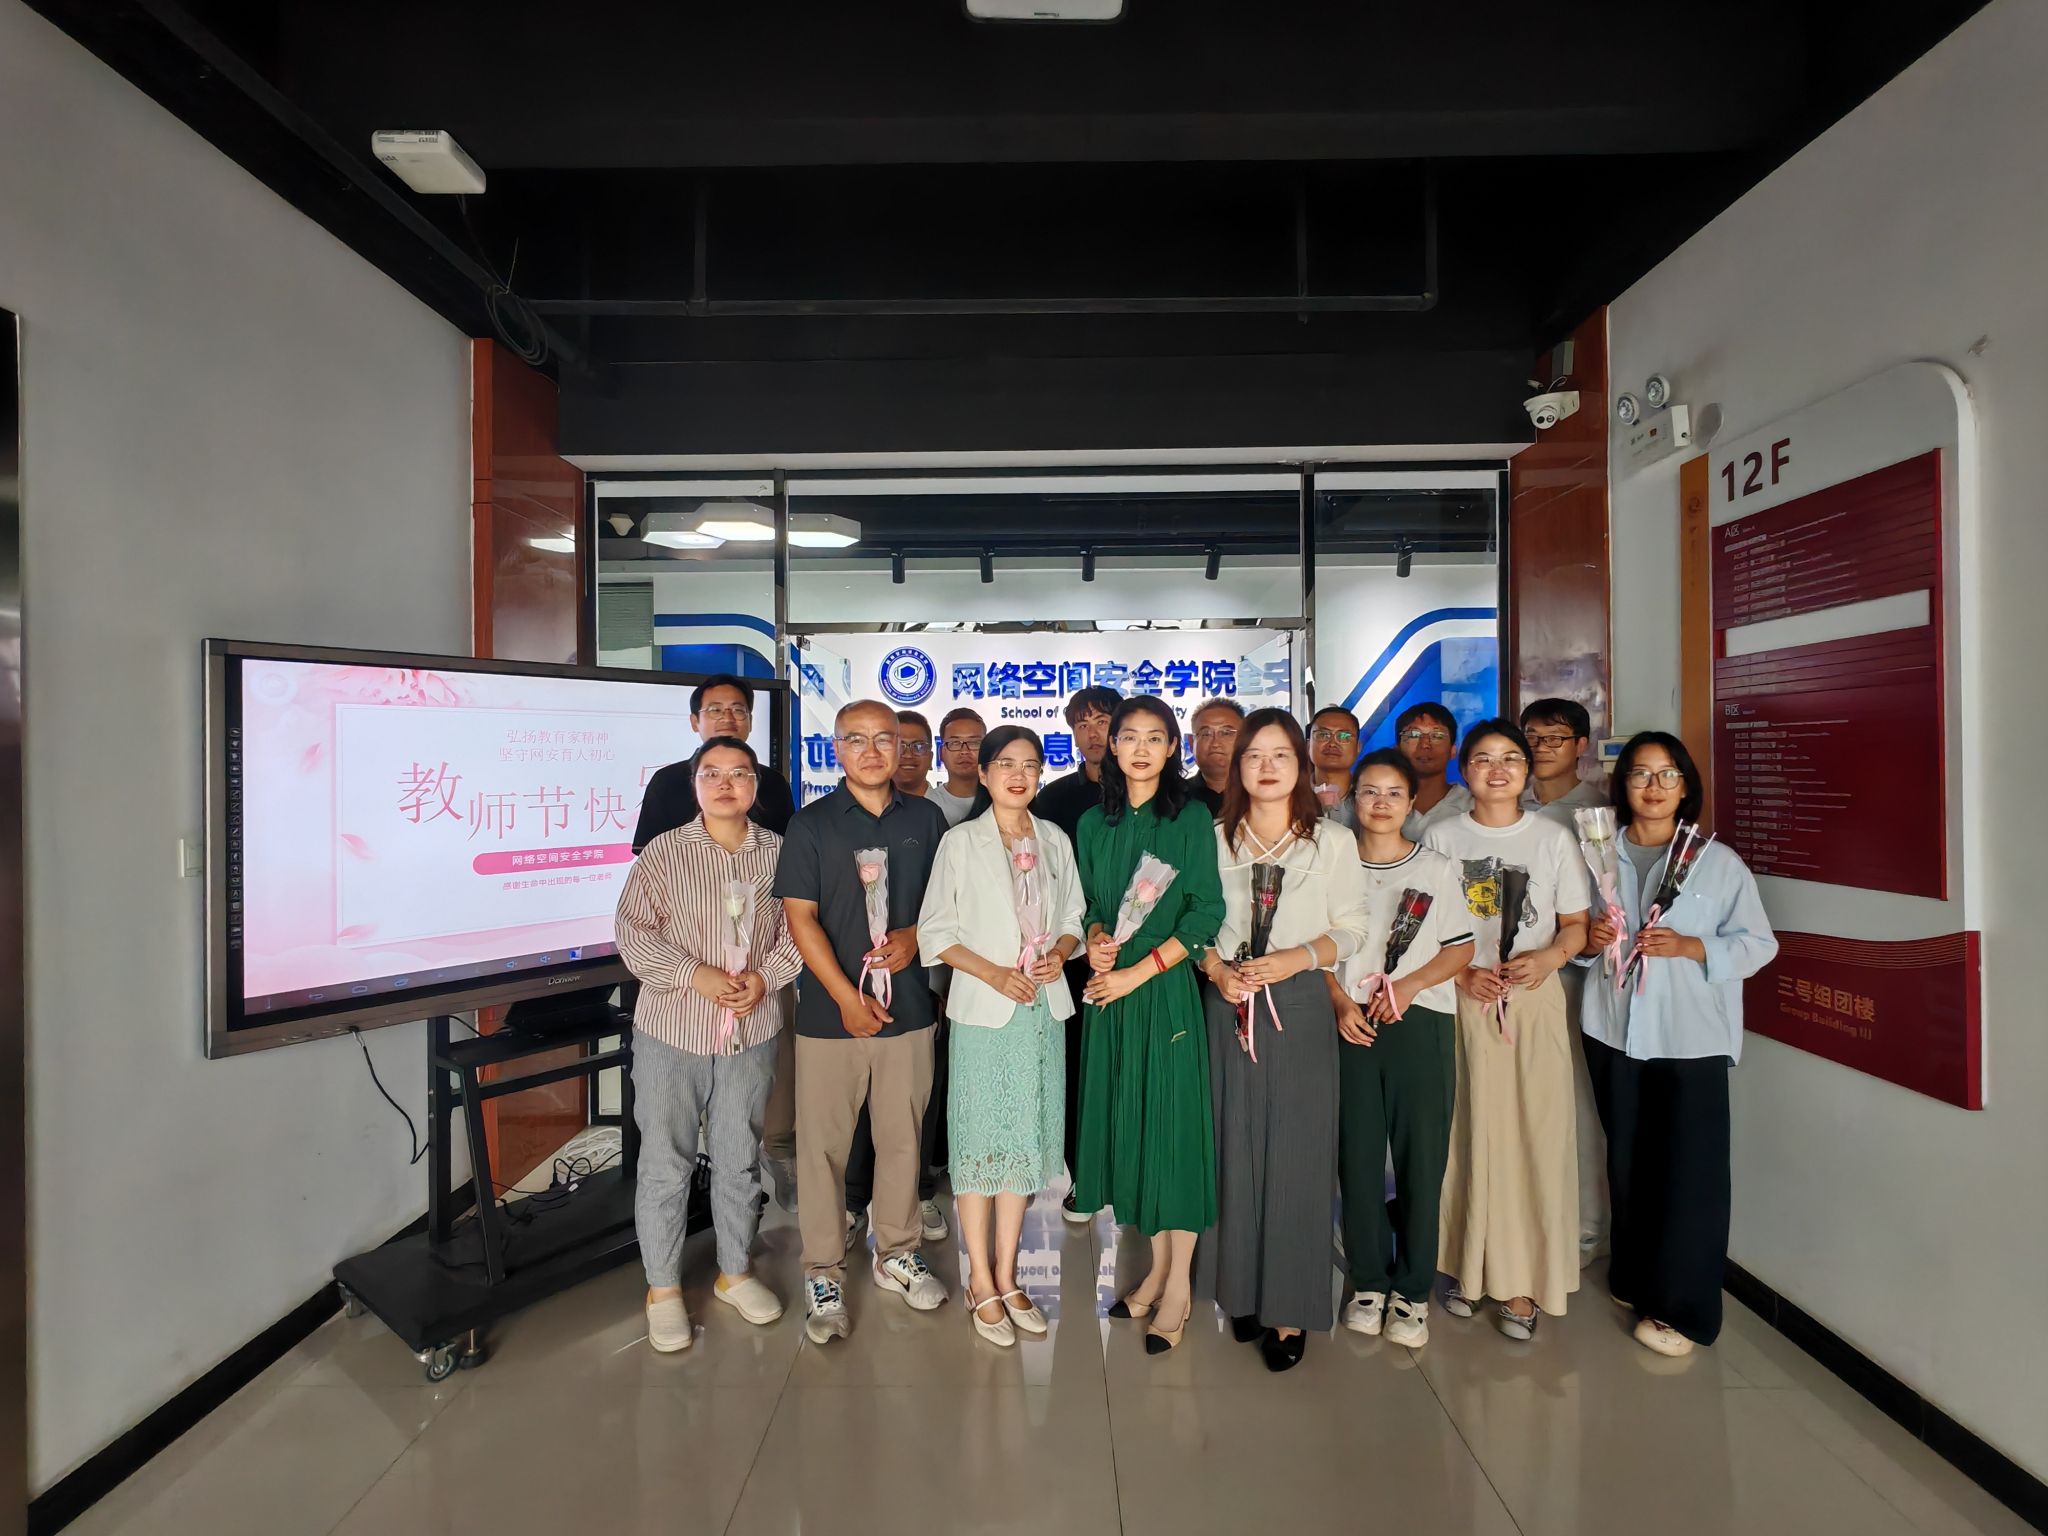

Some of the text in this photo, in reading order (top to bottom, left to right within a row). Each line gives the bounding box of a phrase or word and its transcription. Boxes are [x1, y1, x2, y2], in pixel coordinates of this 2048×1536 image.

[1722, 438, 1790, 502] 12F
[952, 660, 1236, 699] 网络空间安全学院
[1001, 706, 1042, 719] School
[1046, 706, 1059, 719] of
[506, 729, 609, 745] 弘扬教育家精神
[499, 748, 616, 762] 坚守网安育人初心
[512, 849, 604, 866] 网络空间安全学院
[1778, 975, 1875, 1022] 三号组团楼
